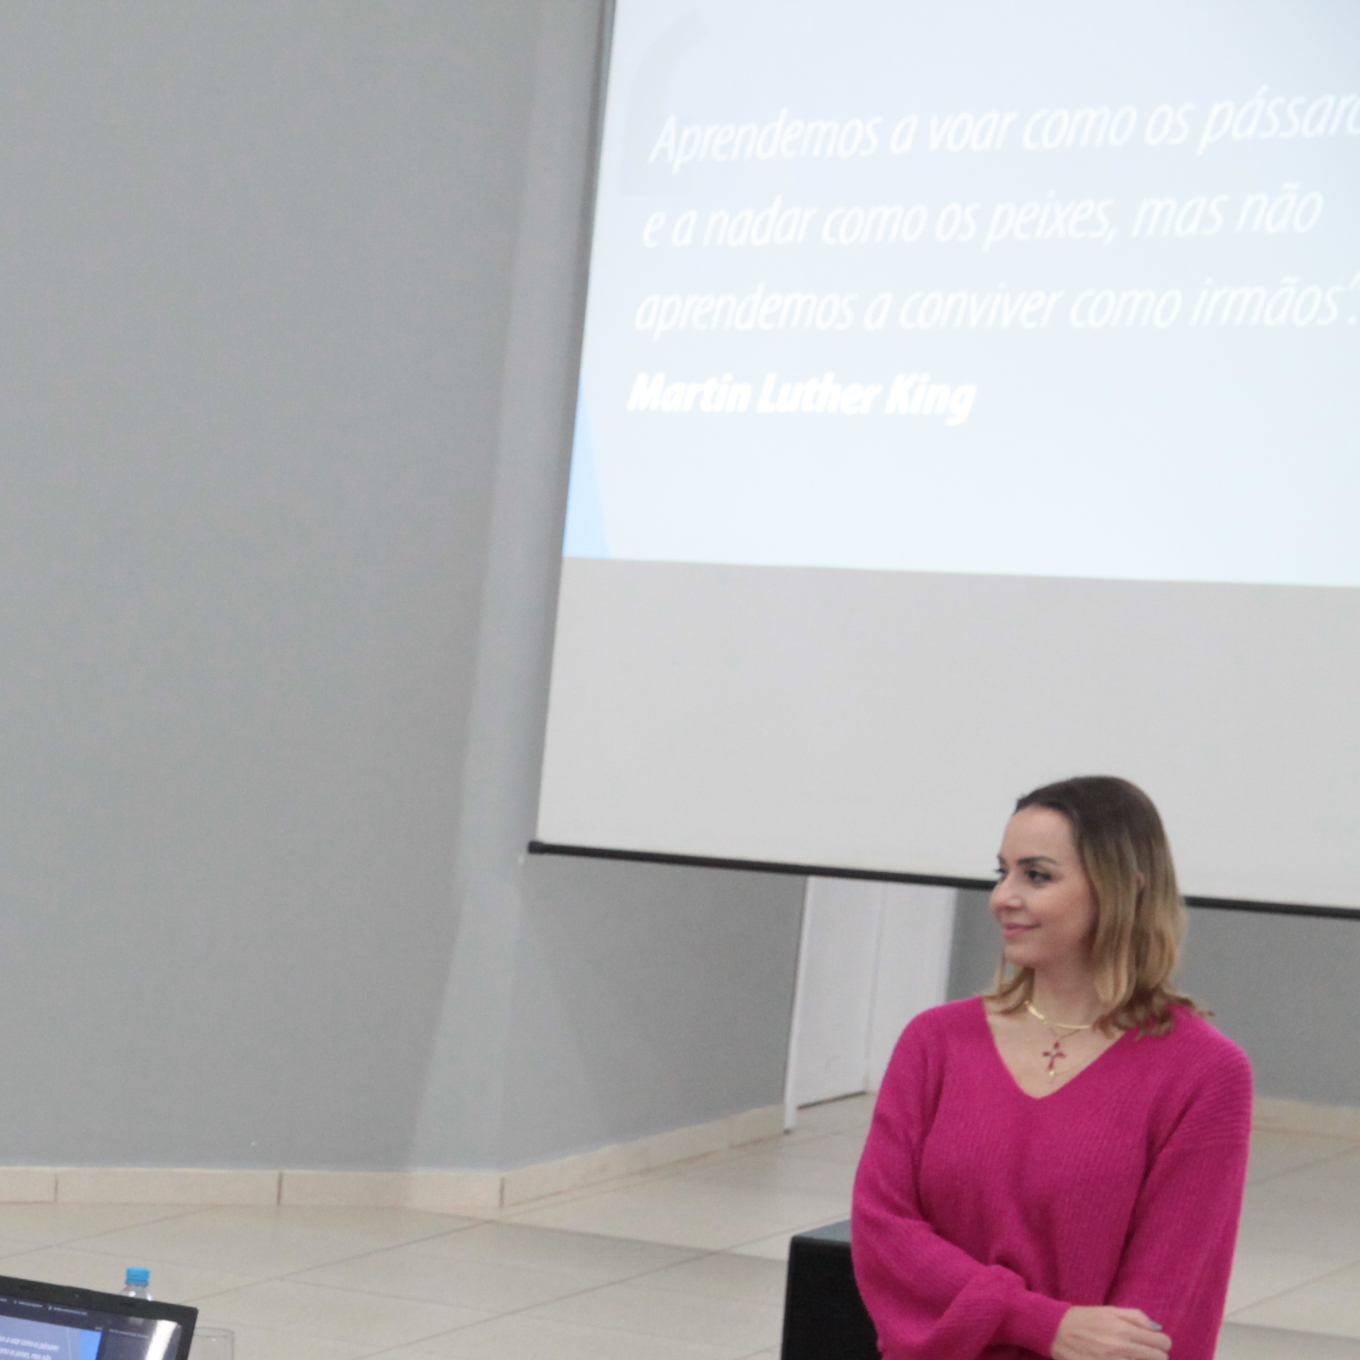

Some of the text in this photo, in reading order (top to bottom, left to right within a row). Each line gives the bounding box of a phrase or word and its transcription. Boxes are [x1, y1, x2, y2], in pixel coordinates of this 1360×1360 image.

[649, 108, 884, 173] Aprendemos
[890, 115, 920, 156] a
[927, 108, 1019, 155] voar
[1022, 104, 1138, 151] como
[1144, 101, 1193, 147] os
[643, 182, 1325, 253] e a nadar como os peixes, mas não
[634, 282, 857, 342] aprendemos
[864, 289, 894, 332] a
[899, 282, 1066, 331] conviver
[1069, 281, 1183, 331] como
[626, 372, 977, 427] Martin Luther King
